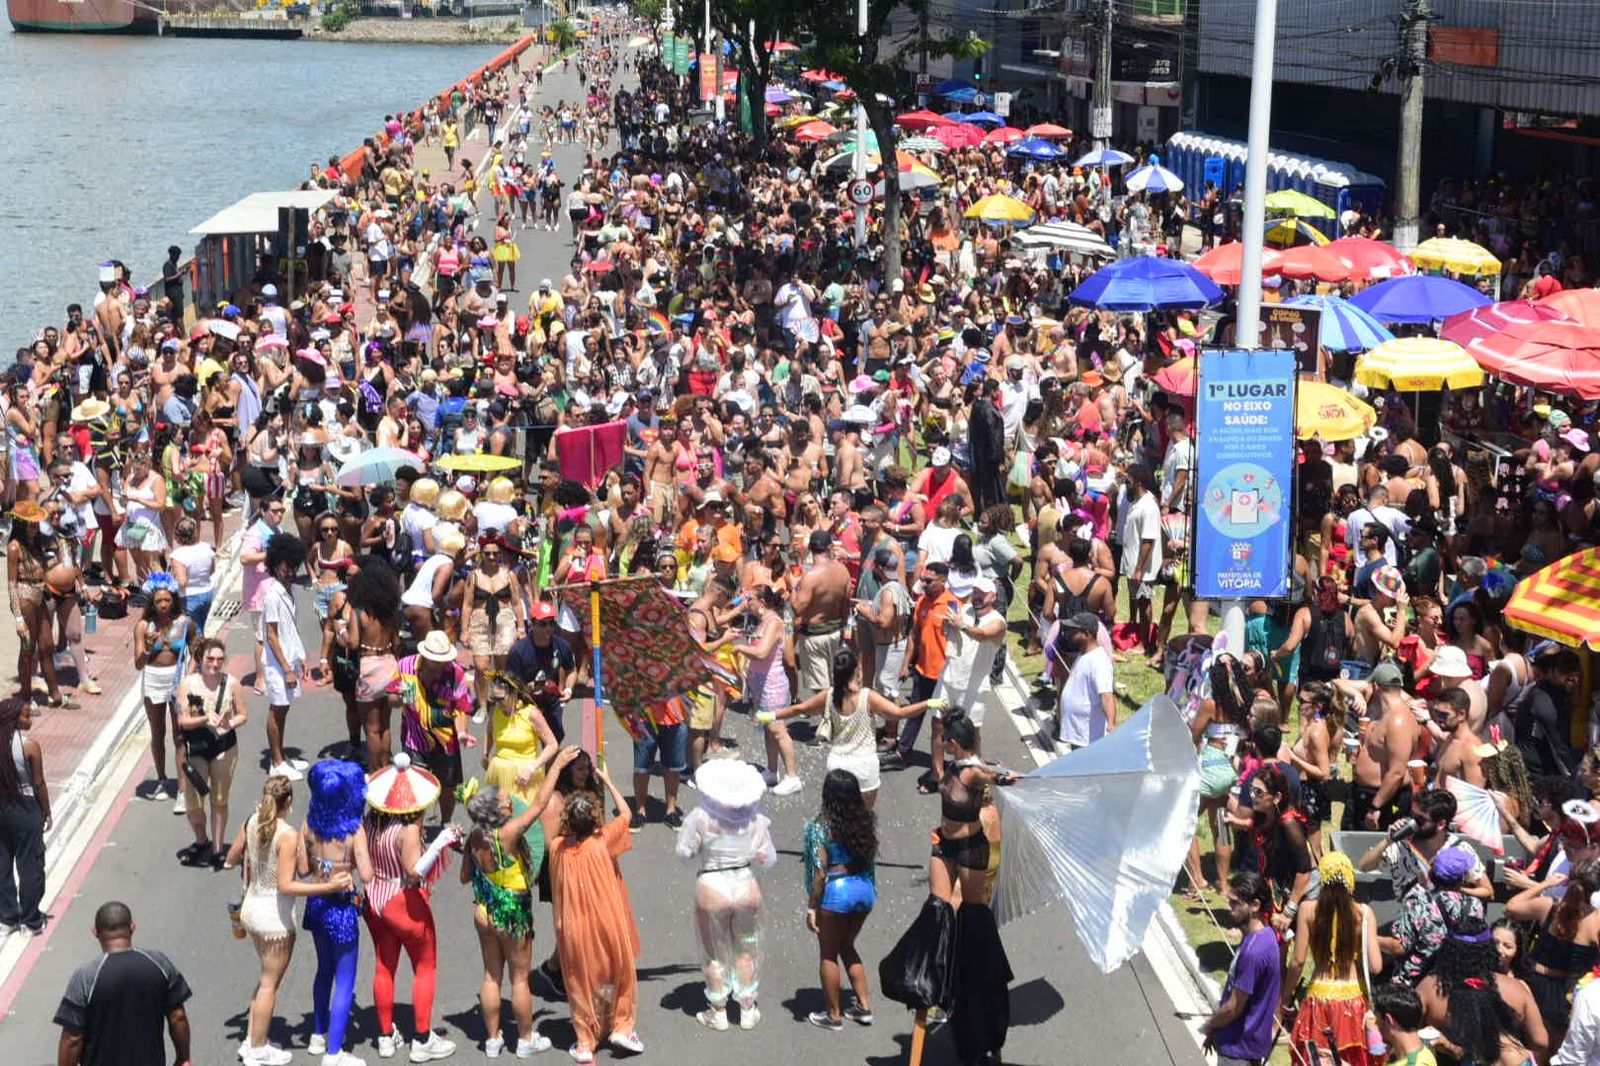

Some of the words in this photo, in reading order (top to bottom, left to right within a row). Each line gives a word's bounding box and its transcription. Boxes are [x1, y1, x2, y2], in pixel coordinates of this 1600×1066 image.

[854, 185, 871, 196] 60
[1209, 384, 1225, 397] 1º
[1228, 384, 1287, 397] LUGAR
[1223, 401, 1242, 411] NO
[1243, 401, 1272, 411] EIXO
[1224, 412, 1269, 425] SAÚDE:
[1218, 578, 1262, 588] VITÓRIA
